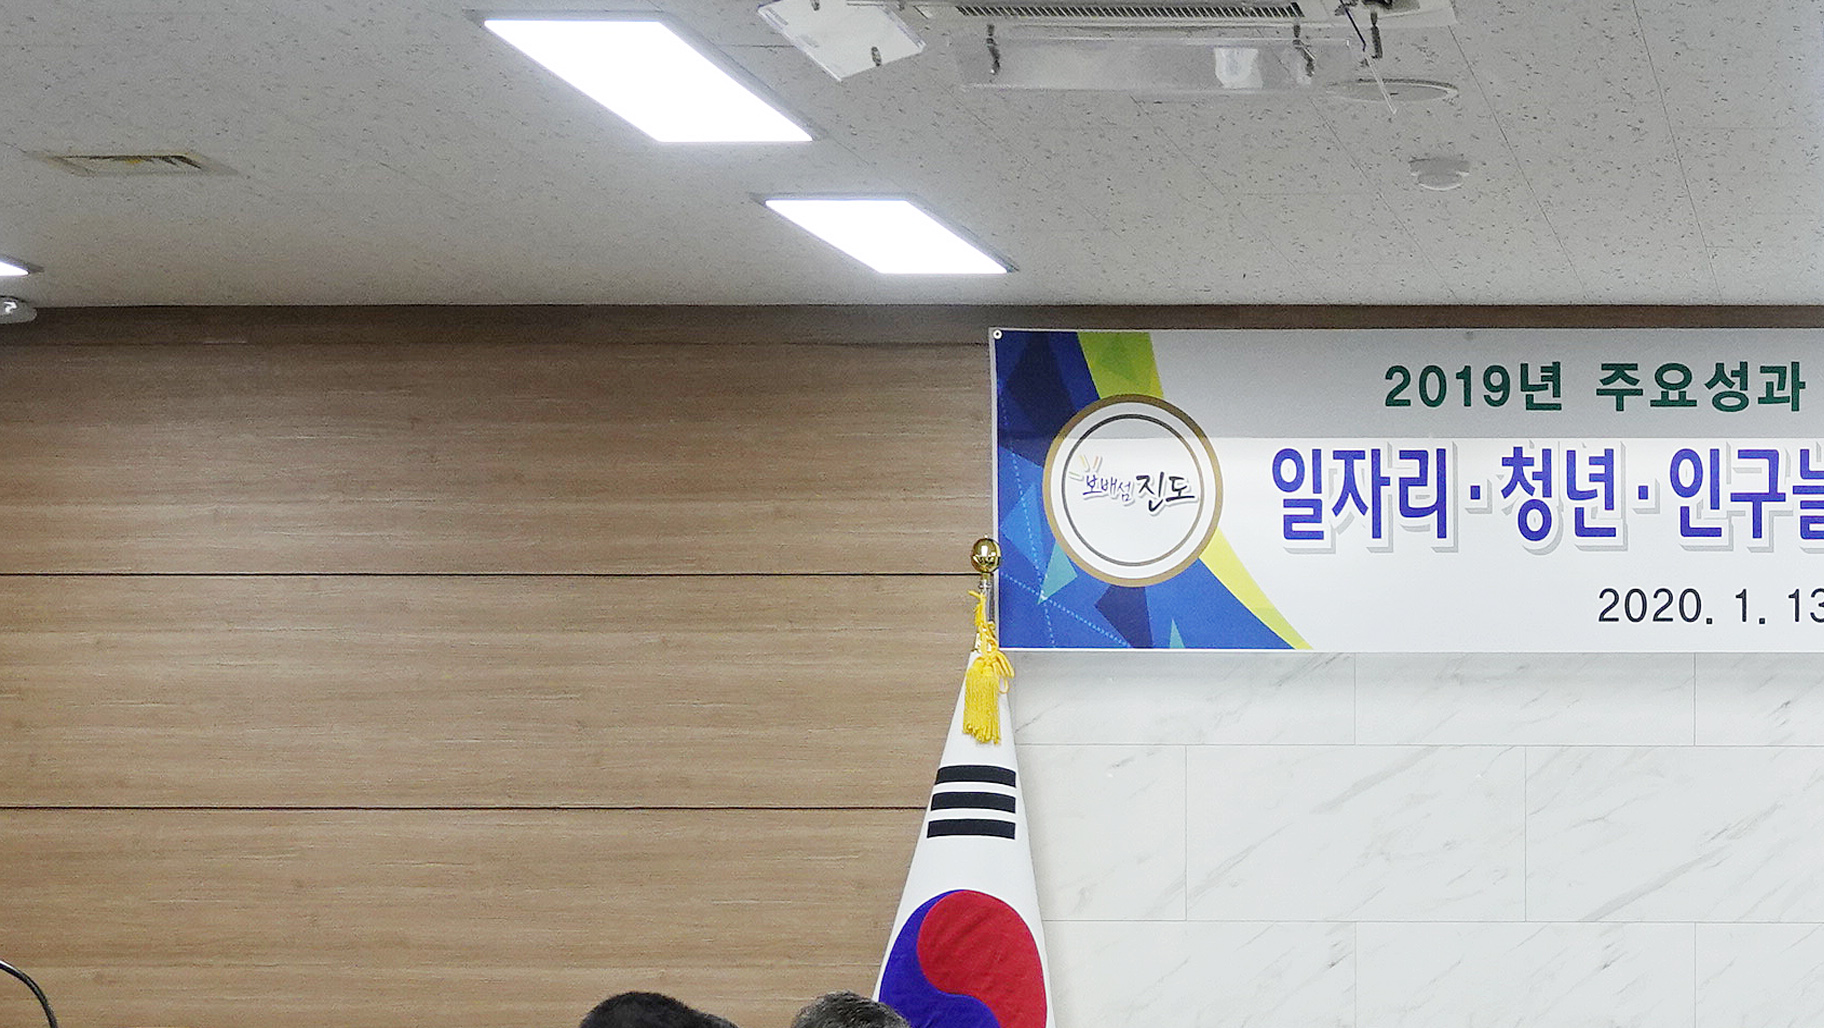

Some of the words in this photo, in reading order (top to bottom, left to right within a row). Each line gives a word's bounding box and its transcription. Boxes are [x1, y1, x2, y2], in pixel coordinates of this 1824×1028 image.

[1384, 360, 1563, 412] 2019년
[1595, 360, 1807, 413] 주요성과
[1082, 474, 1131, 502] 보배섬
[1136, 471, 1196, 513] 진도
[1598, 587, 1713, 625] 2020.
[1735, 588, 1766, 625] 1.
